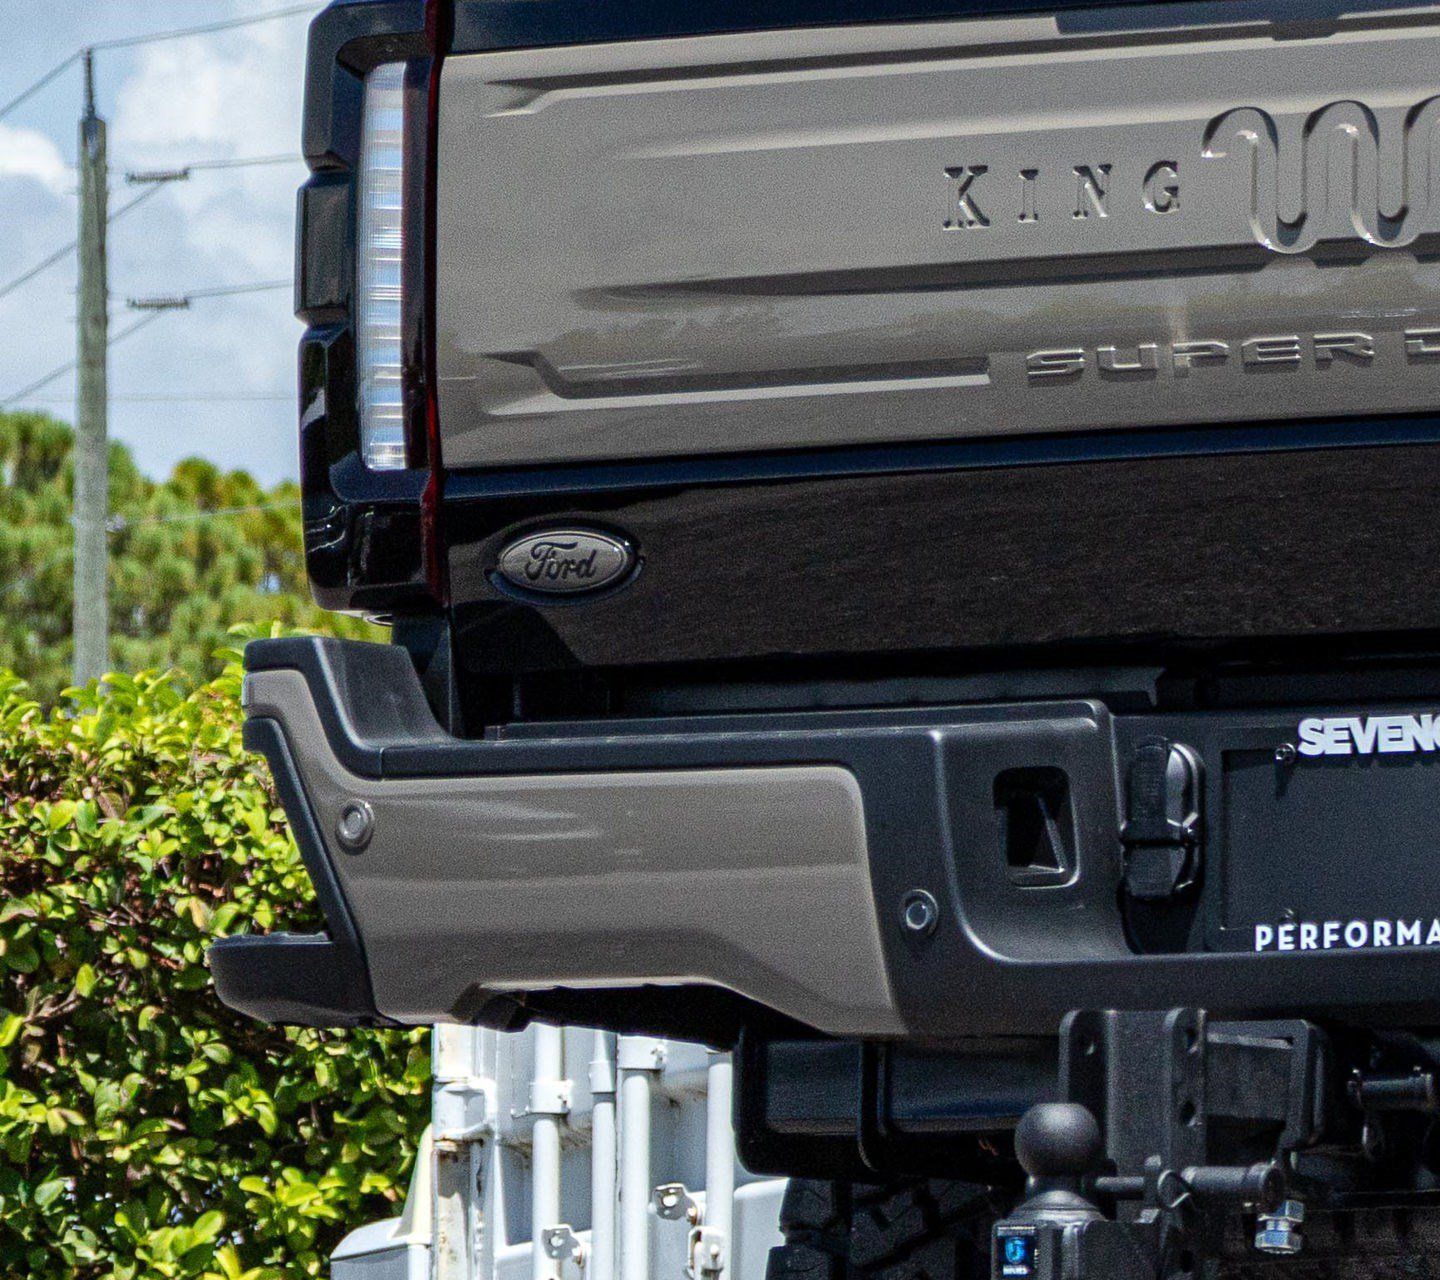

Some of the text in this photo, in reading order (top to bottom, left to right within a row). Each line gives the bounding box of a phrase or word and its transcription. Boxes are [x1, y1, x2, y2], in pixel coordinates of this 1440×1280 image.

[942, 159, 1182, 232] KING
[1026, 330, 1374, 380] SUPER
[525, 541, 597, 581] Ford
